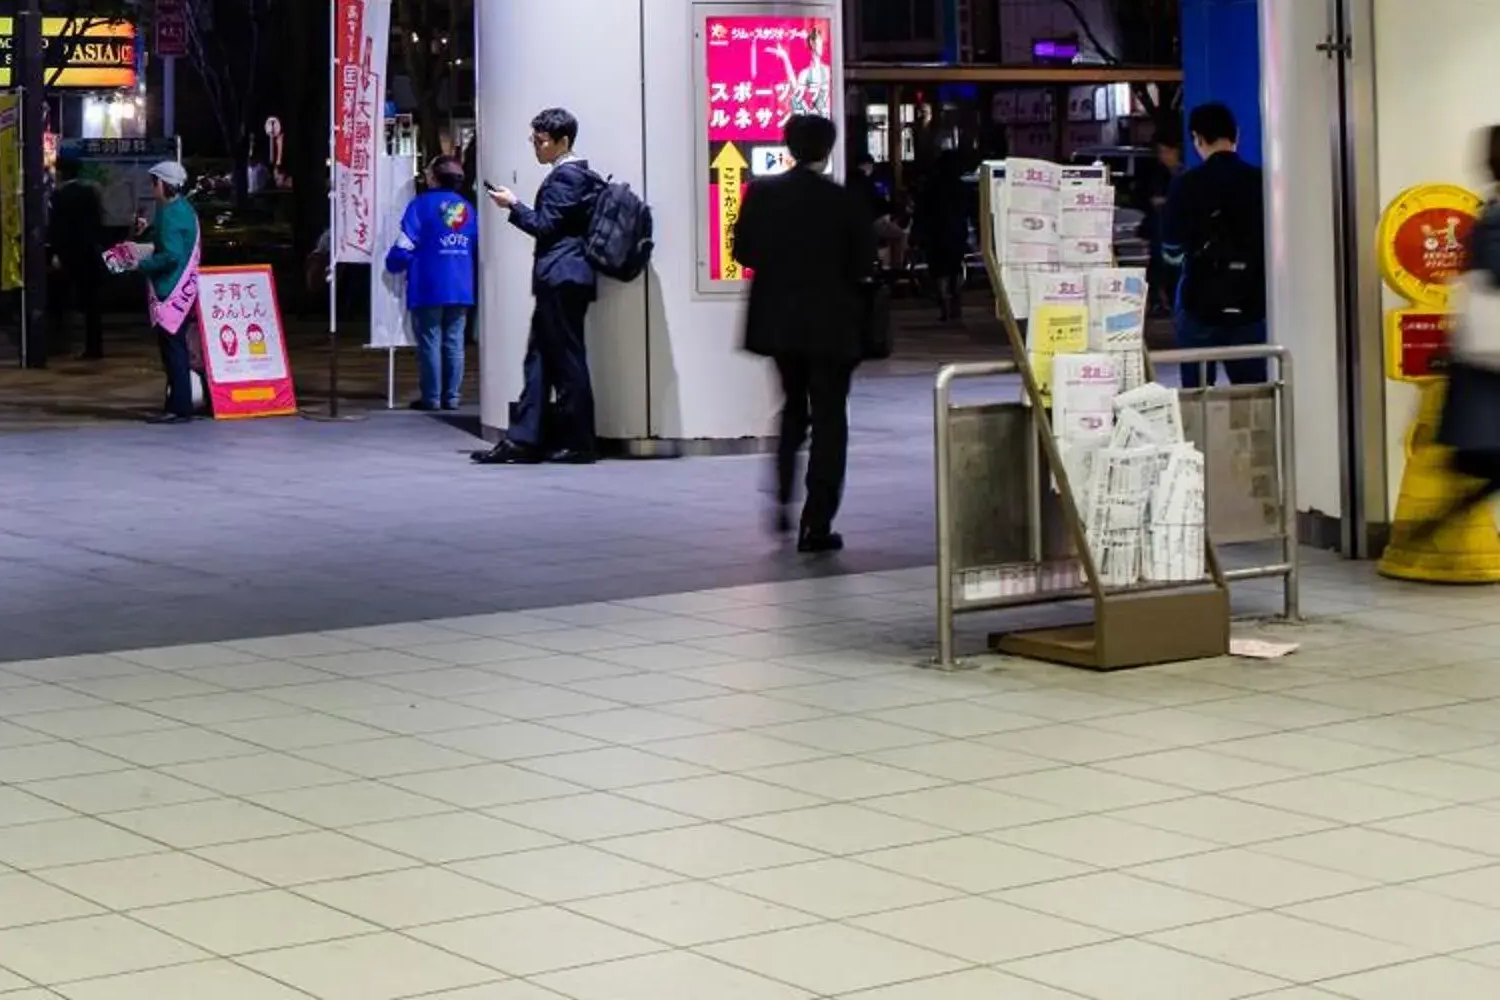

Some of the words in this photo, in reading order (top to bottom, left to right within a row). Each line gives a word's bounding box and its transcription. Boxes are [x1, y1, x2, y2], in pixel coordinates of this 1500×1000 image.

[213, 282, 259, 302] 子育て
[211, 303, 267, 320] あんしん
